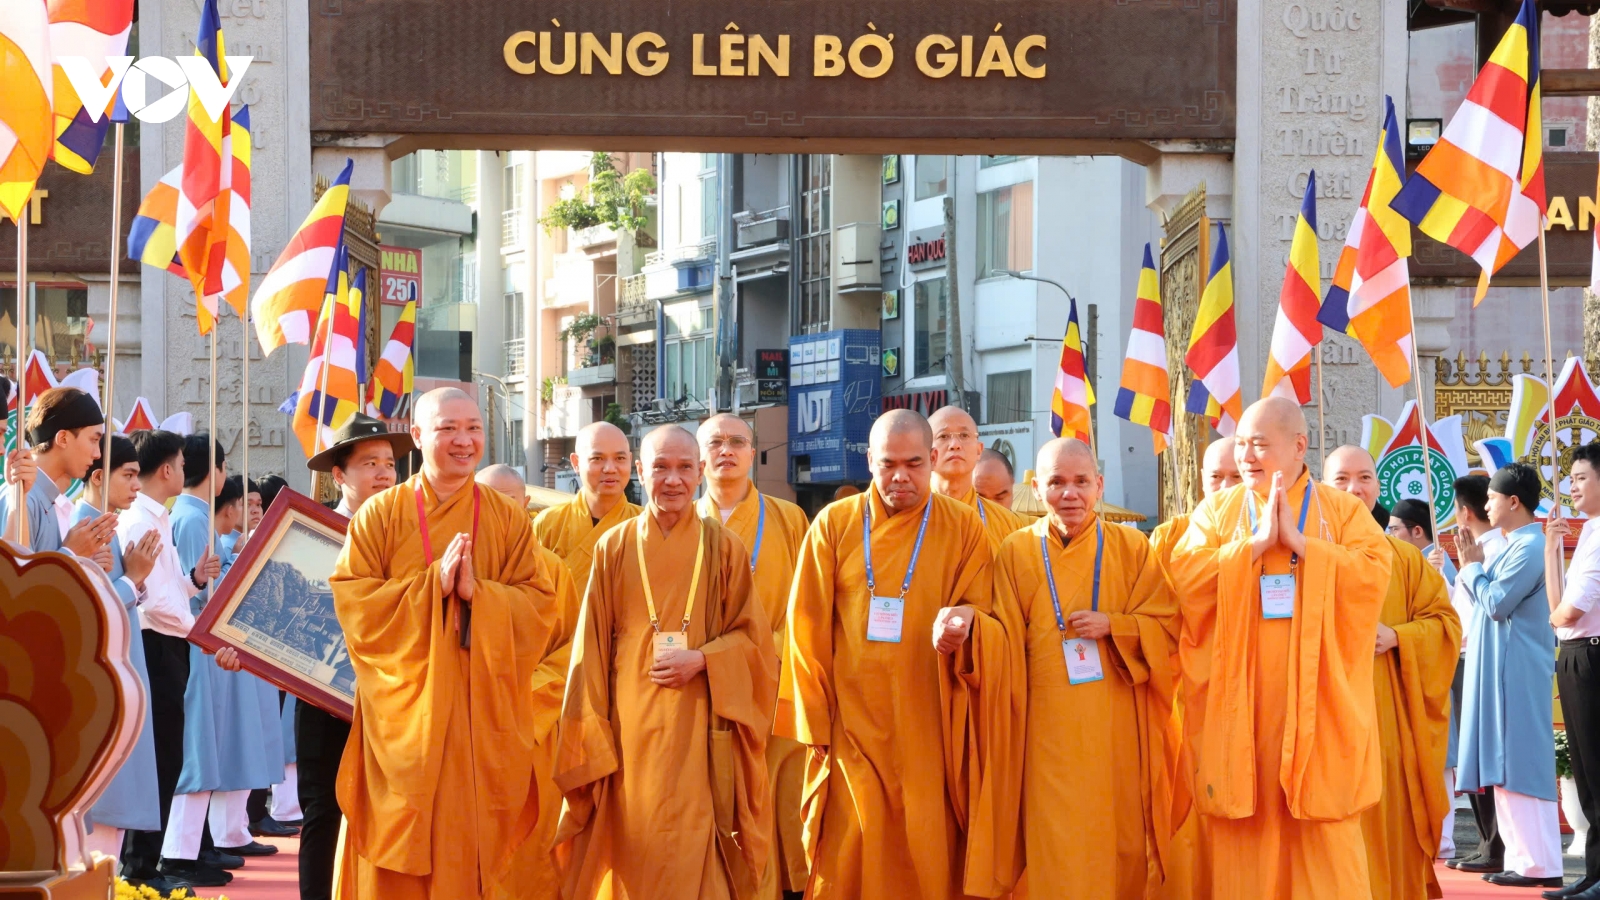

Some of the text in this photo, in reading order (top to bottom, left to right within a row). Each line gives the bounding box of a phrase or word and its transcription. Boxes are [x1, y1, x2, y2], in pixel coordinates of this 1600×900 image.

[1282, 0, 1362, 38] Quốc
[503, 18, 1046, 78] CÙNG LÊN BỜ GIÁC
[382, 250, 418, 273] NHÀ
[761, 351, 783, 361] NAIL
[767, 367, 778, 376] MI
